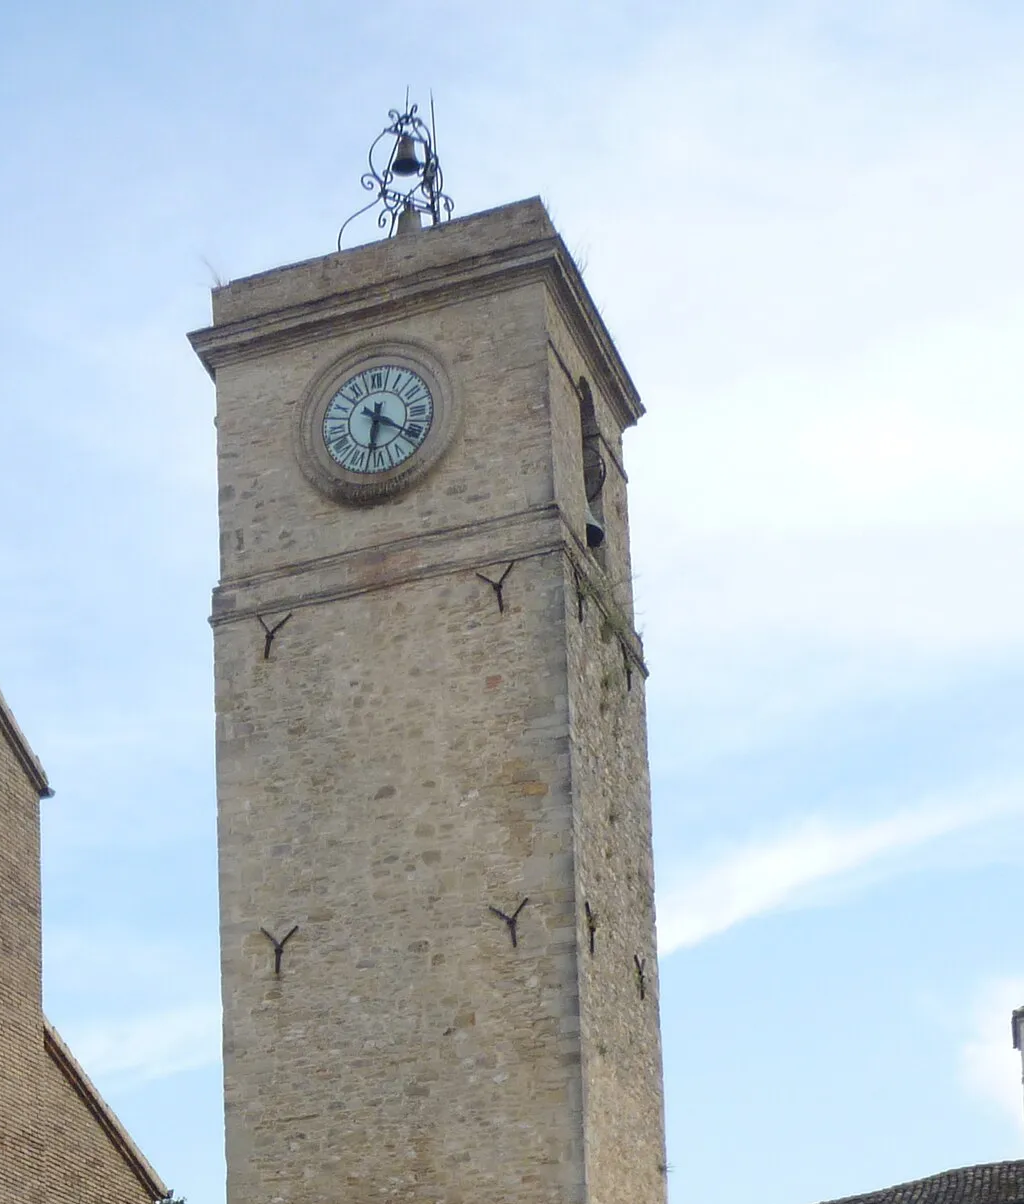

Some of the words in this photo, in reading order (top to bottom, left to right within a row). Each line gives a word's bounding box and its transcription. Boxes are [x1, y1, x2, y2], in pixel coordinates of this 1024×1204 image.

[371, 373, 382, 389] XII
[392, 374, 401, 389] I
[349, 383, 363, 399] XI
[404, 385, 420, 399] II
[333, 404, 348, 413] X
[409, 405, 425, 417] III
[394, 443, 405, 458] V
[373, 451, 384, 468] VI
